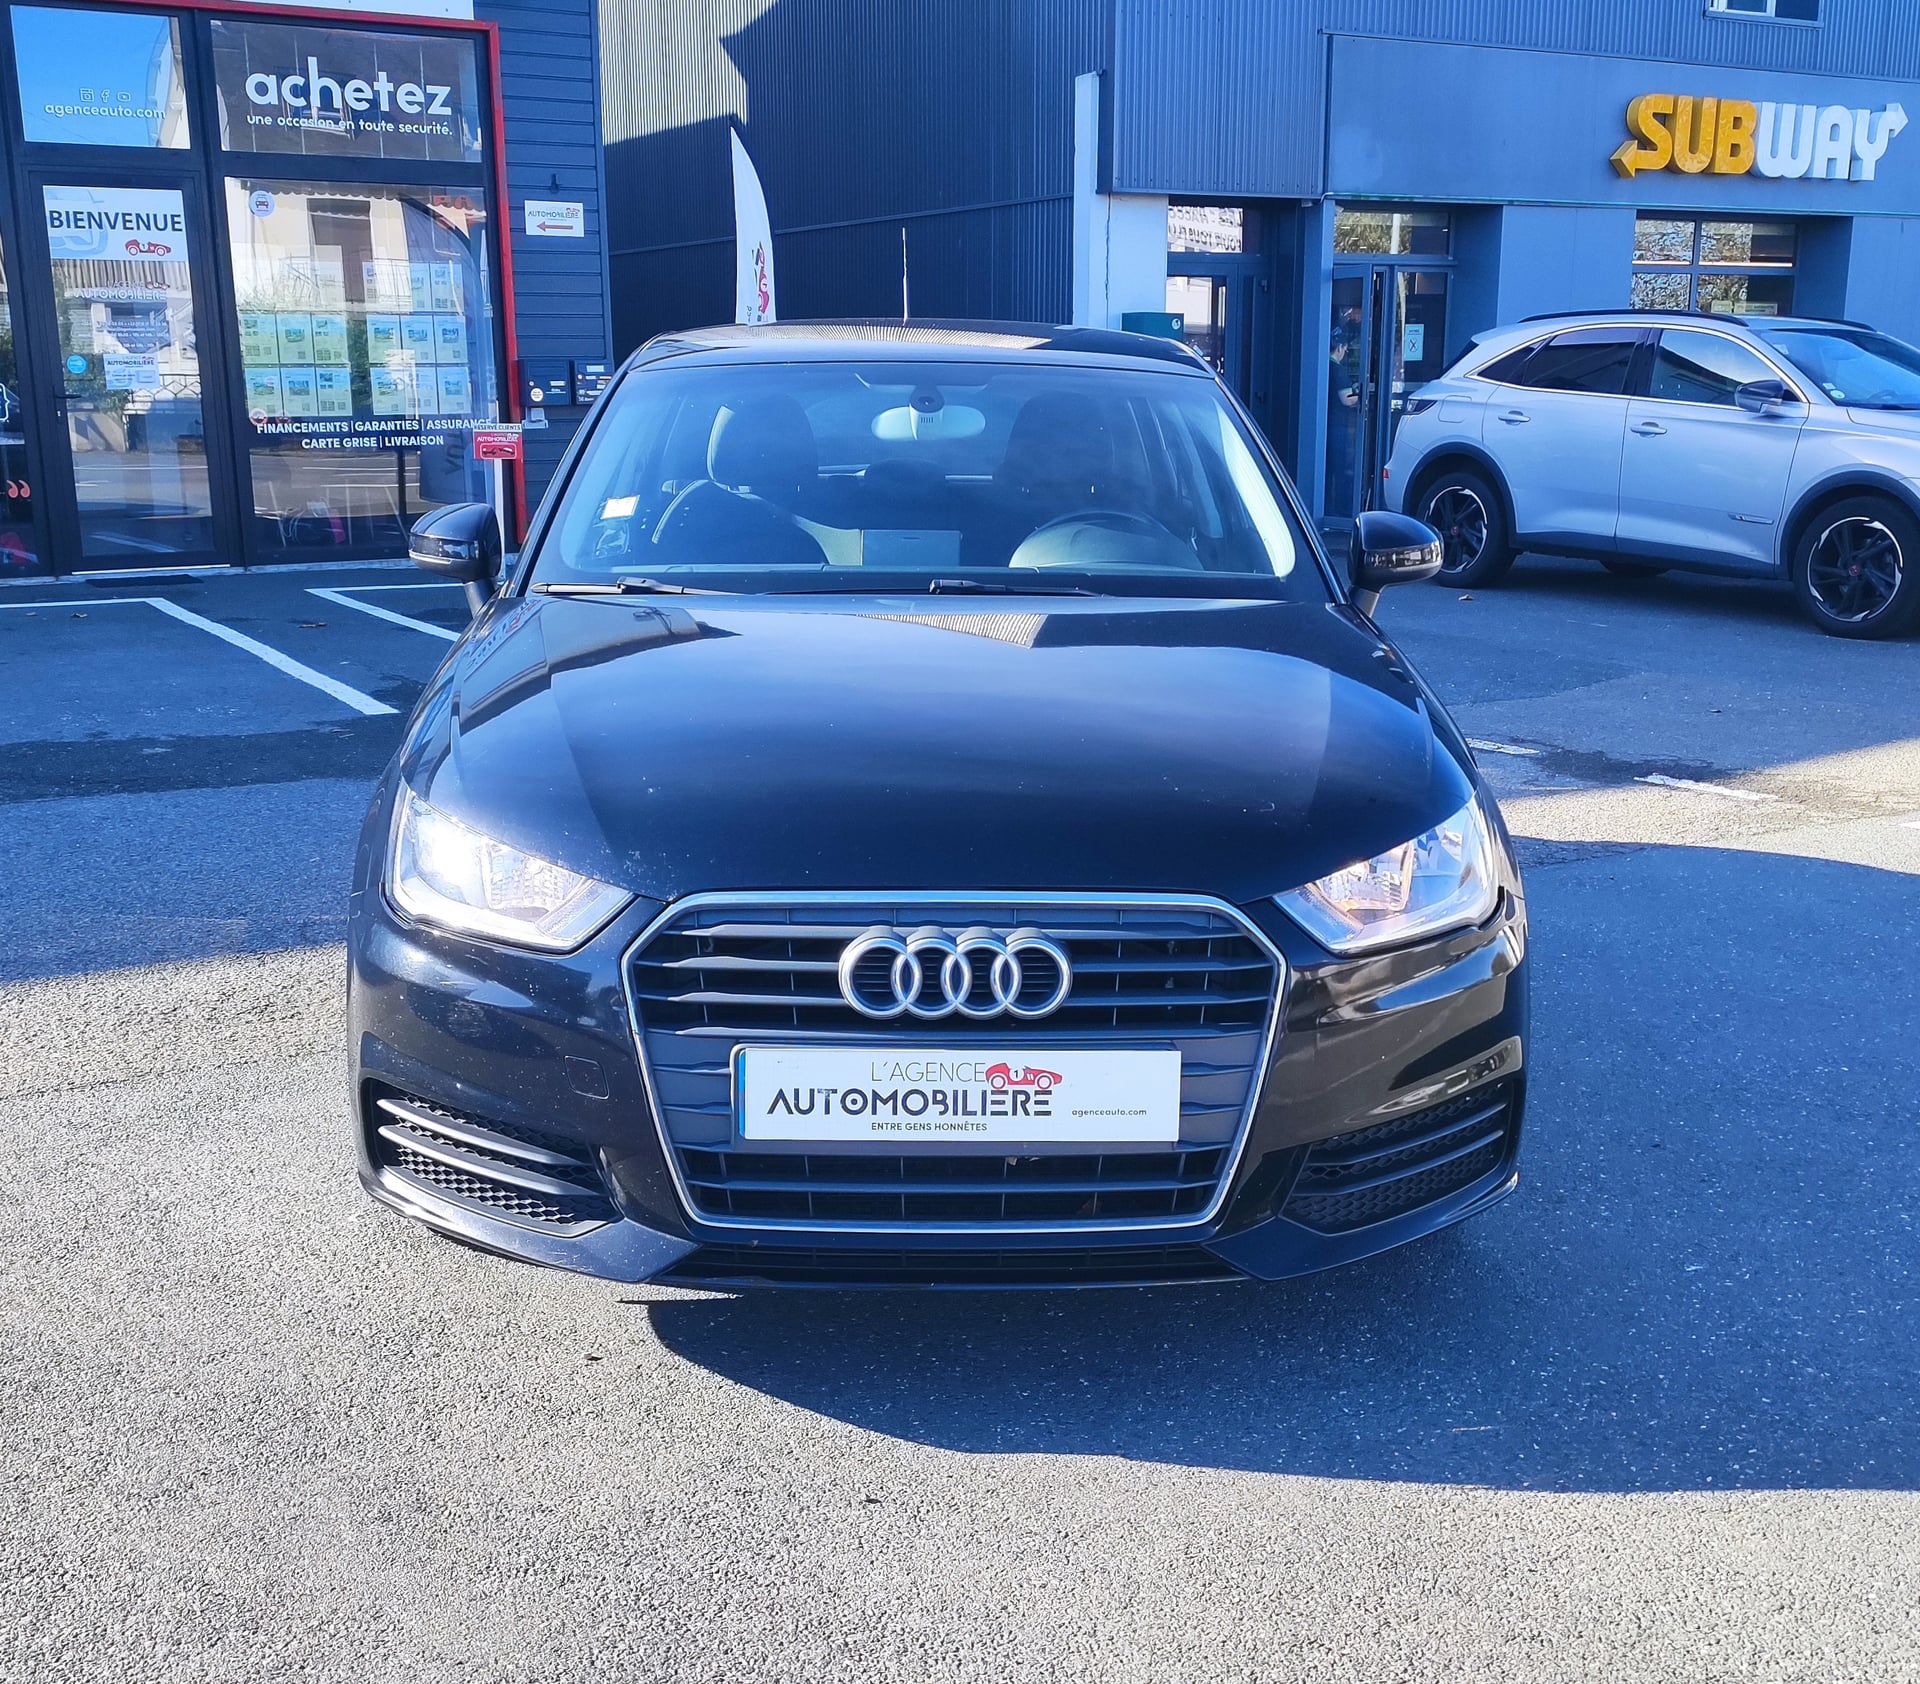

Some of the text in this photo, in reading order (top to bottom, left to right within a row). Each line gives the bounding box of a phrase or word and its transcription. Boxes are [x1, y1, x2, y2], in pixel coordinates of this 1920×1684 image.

[245, 56, 452, 116] achetez
[45, 103, 166, 120] agenceauto.com
[247, 114, 453, 136] une occasion en toute securité.
[1610, 94, 1909, 181] SUBWAY
[49, 210, 183, 232] BIENVENUE
[256, 421, 349, 434] FINANCEMENTS
[354, 420, 419, 432] GARANTIES
[301, 434, 444, 449] CARTE GRISE LIVRAISON
[871, 1061, 986, 1082] L'AGENCE
[1071, 1108, 1147, 1118] agenceauto.com
[871, 1120, 988, 1131] ENTRE GENS HONNÊTES
